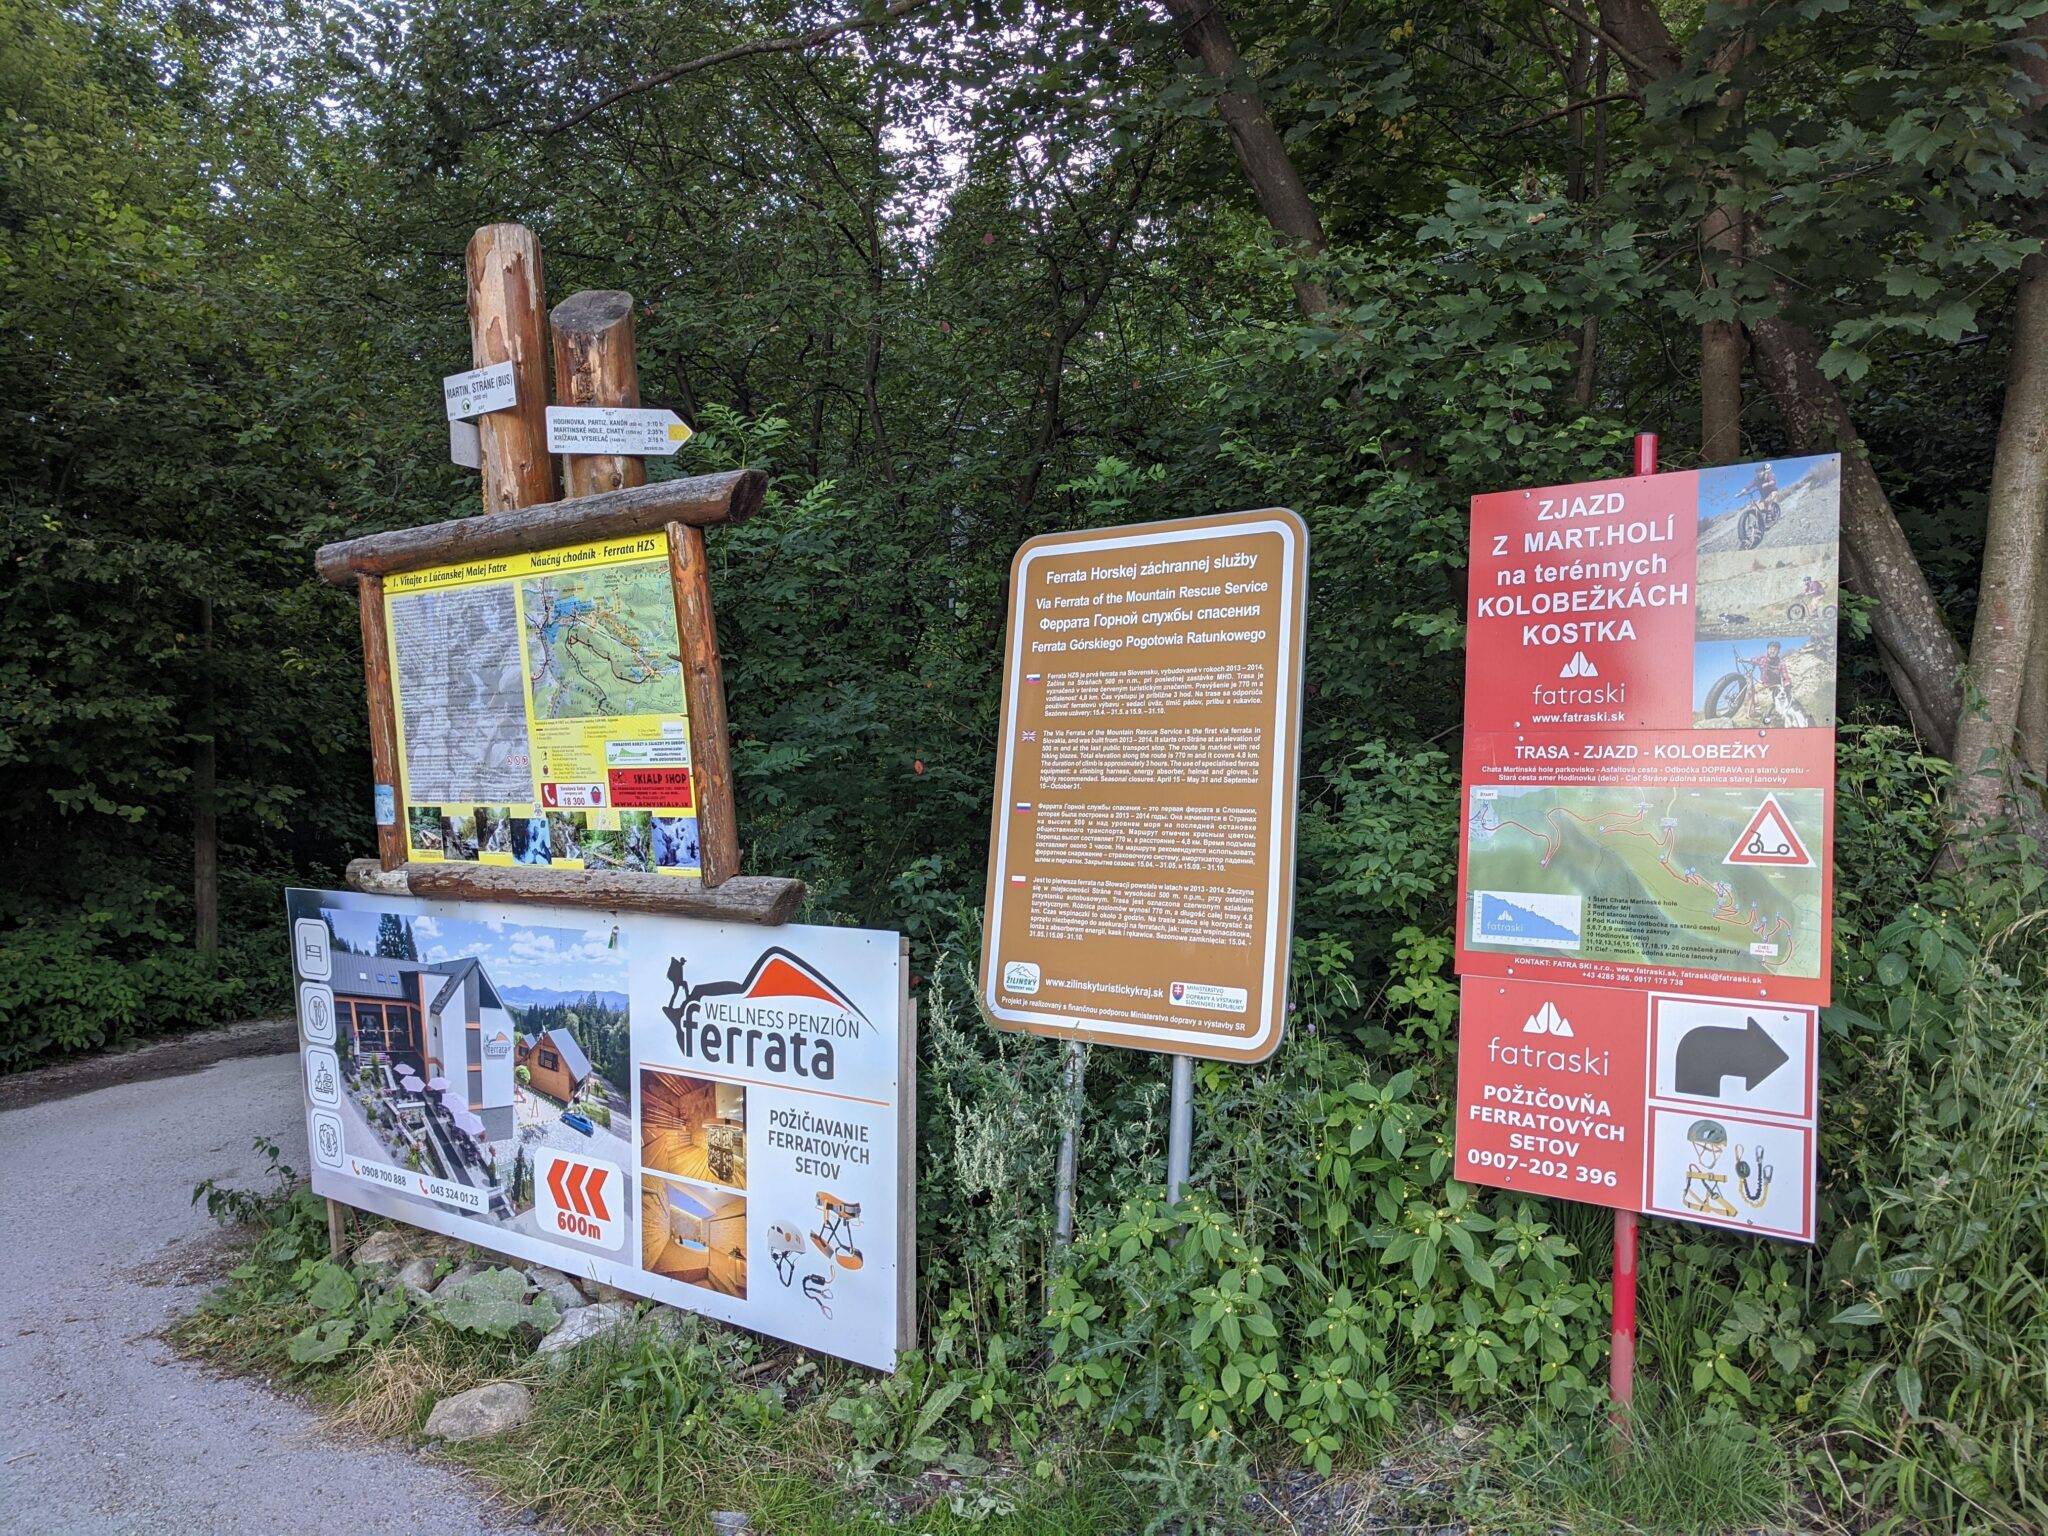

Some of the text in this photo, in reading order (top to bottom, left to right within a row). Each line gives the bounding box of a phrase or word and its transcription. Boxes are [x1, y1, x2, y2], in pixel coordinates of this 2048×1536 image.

[447, 384, 471, 399] MARTIN,
[472, 377, 495, 393] STRÁNE
[496, 374, 512, 389] (BUS)
[581, 434, 608, 442] VYSIELAČ
[1537, 492, 1625, 521] ZJAZD
[1492, 514, 1674, 556] Z MART.HOLÍ
[530, 539, 654, 568] Náučný chodník Ferrata HZS
[400, 570, 422, 587] Vítajte
[429, 566, 464, 582] Lúčanskej
[466, 565, 486, 578] Malej
[488, 563, 507, 573] Fatre
[1047, 551, 1258, 584] Ferrata Horskej záchrannej služby
[1497, 554, 1667, 586] na terénnych
[1036, 579, 1268, 609] Via Ferrata of the Mountain Rescue Service
[1477, 583, 1688, 617] KOLOBEŽKÁCH
[1040, 606, 1260, 632] Феррата Горной службы спасения
[1032, 627, 1266, 653] Ferrata Górskiego Pogotowia Ratunkowego
[1522, 620, 1636, 646] KOSTKA
[1532, 682, 1625, 705] fatraski
[1532, 711, 1625, 723] www.fatraski.sk
[1515, 746, 1569, 760] TRASA
[1583, 745, 1638, 760] ZJAZD
[1654, 741, 1769, 759] KOLOBEŽKY
[634, 773, 686, 784] SKIALP SHOP
[1555, 766, 1595, 775] parkovisko
[1729, 775, 1752, 784] starej
[1755, 776, 1787, 784] lanovky
[572, 797, 585, 805] 300
[1487, 922, 1523, 932] fatraski
[1514, 957, 1551, 967] KONTAKT:
[1553, 960, 1577, 969] FATRA
[1681, 971, 1762, 985] fatraski@fatraski.sk
[1582, 970, 1595, 978] +43
[1597, 972, 1614, 980] 4285
[1634, 975, 1652, 983] 0917
[1670, 978, 1684, 986] 738
[1045, 977, 1164, 999] www.zilinskyturistickykraj.sk
[704, 1002, 860, 1039] WELLNESS PENZIÓN
[1002, 995, 1022, 1006] Projekt
[1023, 998, 1028, 1007] je
[1029, 998, 1062, 1009] realizovaný
[1068, 1003, 1097, 1013] finančnou
[1099, 1006, 1129, 1018] podporou
[1130, 1010, 1169, 1021] Ministerstva
[1170, 1014, 1197, 1026] dopravy
[1204, 1018, 1234, 1030] výstavby
[1236, 1022, 1246, 1030] SR
[683, 1002, 834, 1080] ferrata
[1487, 1036, 1609, 1077] fatraski
[1483, 1083, 1611, 1117] POŽIČOVŇA
[770, 1108, 869, 1143] POŽIČIAVANIE
[1470, 1106, 1625, 1142] FERRATOVÝCH
[768, 1130, 870, 1165] FERRATOVÝCH
[1510, 1133, 1580, 1158] SETOV
[362, 1165, 406, 1186] 0908 700 888
[795, 1156, 840, 1180] SETOV
[1468, 1148, 1618, 1188] 0907-202 396
[431, 1184, 479, 1206] 043 324 01 23
[557, 1211, 602, 1241] 600m
